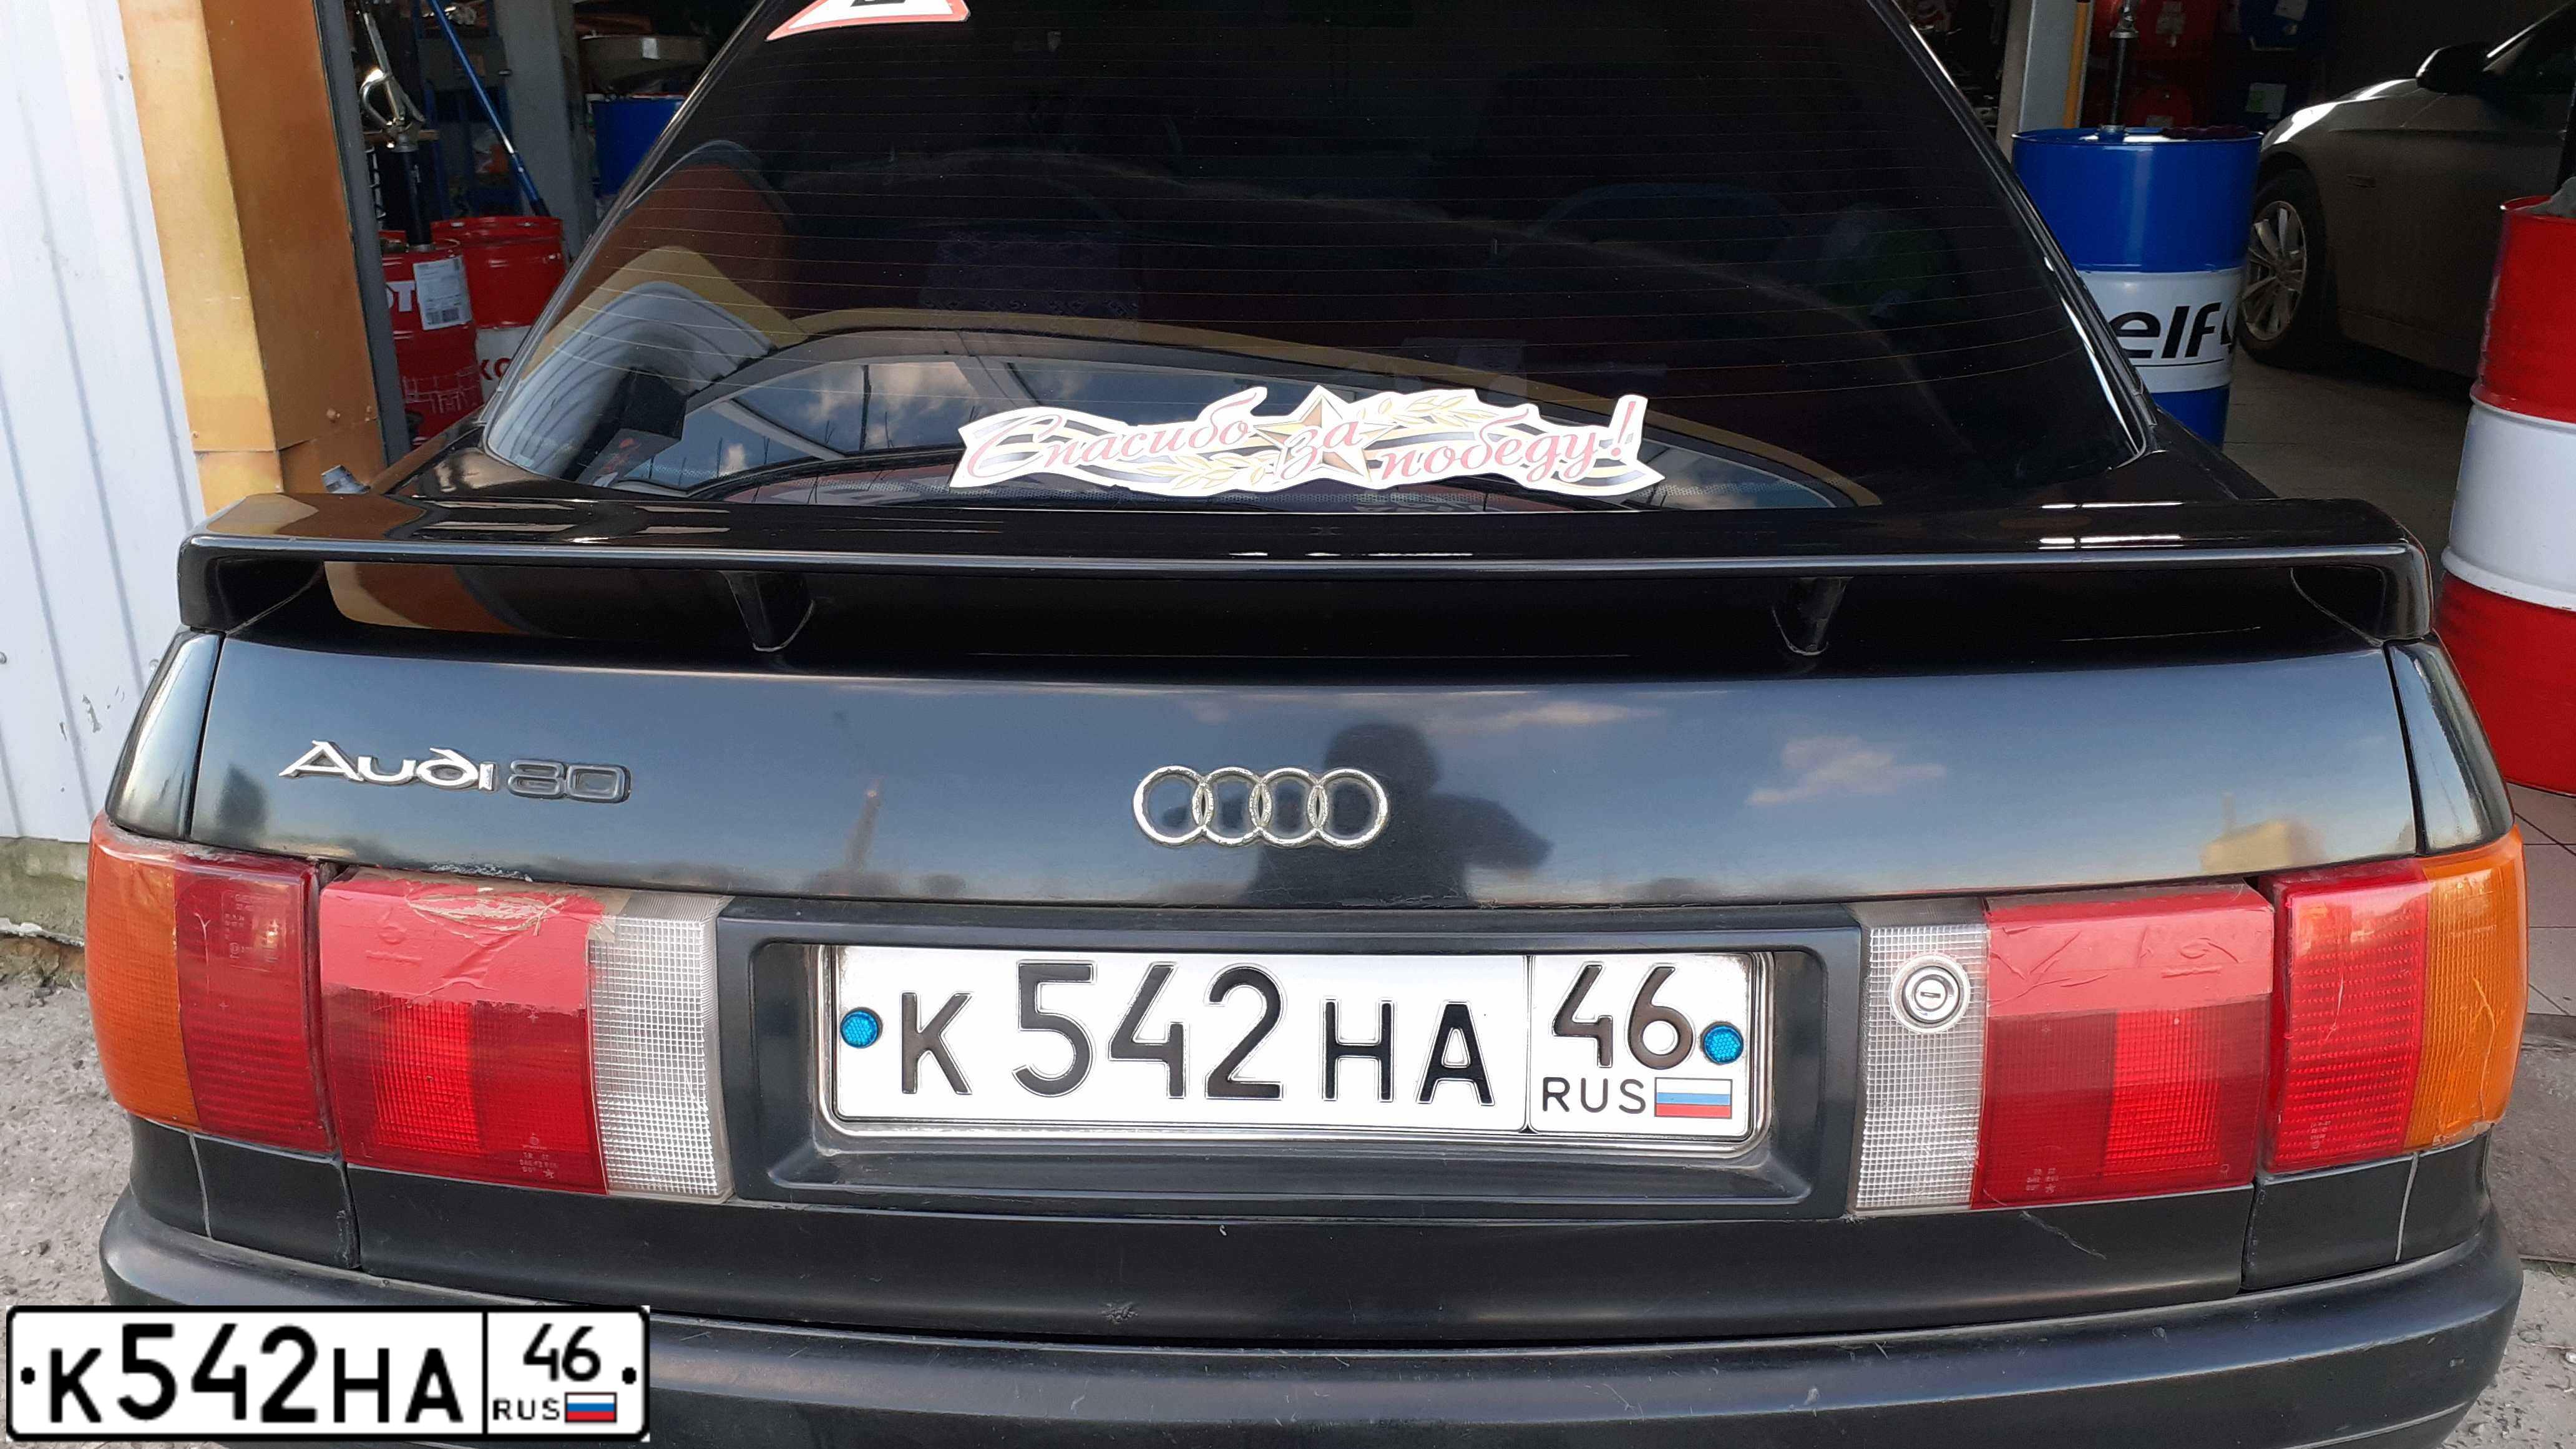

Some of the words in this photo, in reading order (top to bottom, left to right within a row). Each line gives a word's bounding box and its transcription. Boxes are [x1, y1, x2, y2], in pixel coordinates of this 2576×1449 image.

[2108, 302, 2222, 358] elf
[968, 392, 1257, 477] Спасибо
[1281, 420, 1362, 480] за
[1381, 401, 1636, 482] победу!
[279, 739, 496, 793] Audi
[507, 759, 632, 803] 80
[1552, 962, 1694, 1070] 46
[1542, 1076, 1646, 1114] RUS
